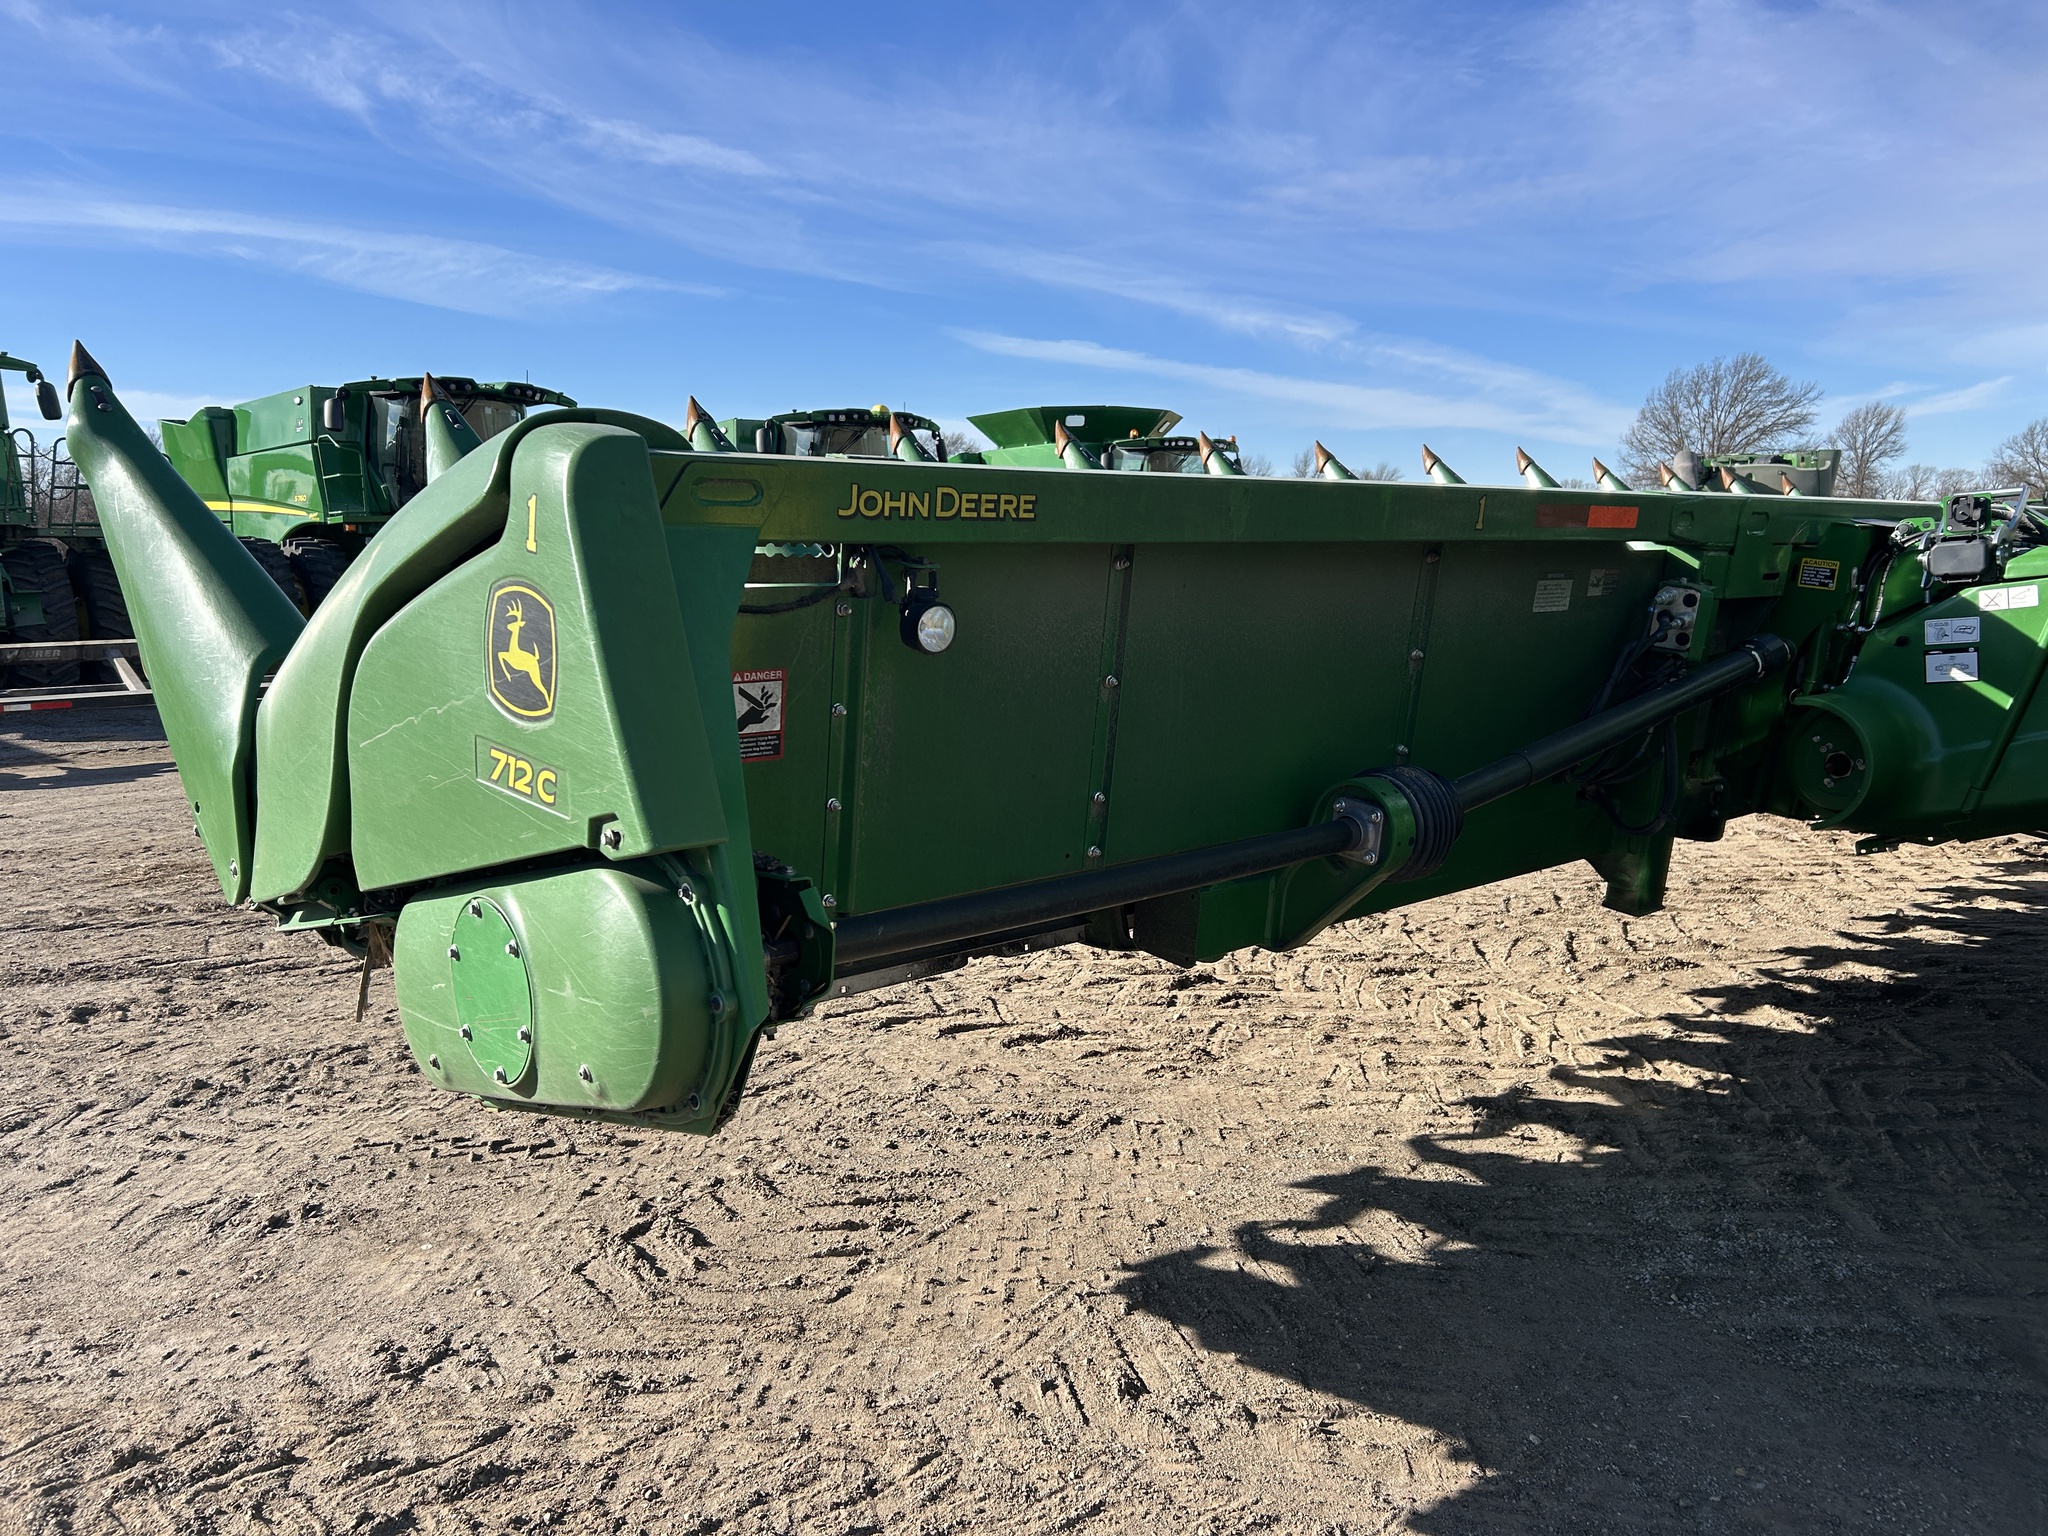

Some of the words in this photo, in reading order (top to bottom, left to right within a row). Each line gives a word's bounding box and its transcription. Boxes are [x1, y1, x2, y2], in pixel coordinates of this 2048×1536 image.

[837, 483, 930, 520] JOHN
[935, 486, 1037, 520] DEERE
[1475, 495, 1487, 530] 1
[526, 493, 538, 555] 1
[1808, 559, 1838, 568] CAUTION
[744, 670, 783, 681] DANGER
[488, 745, 558, 807] 712C
